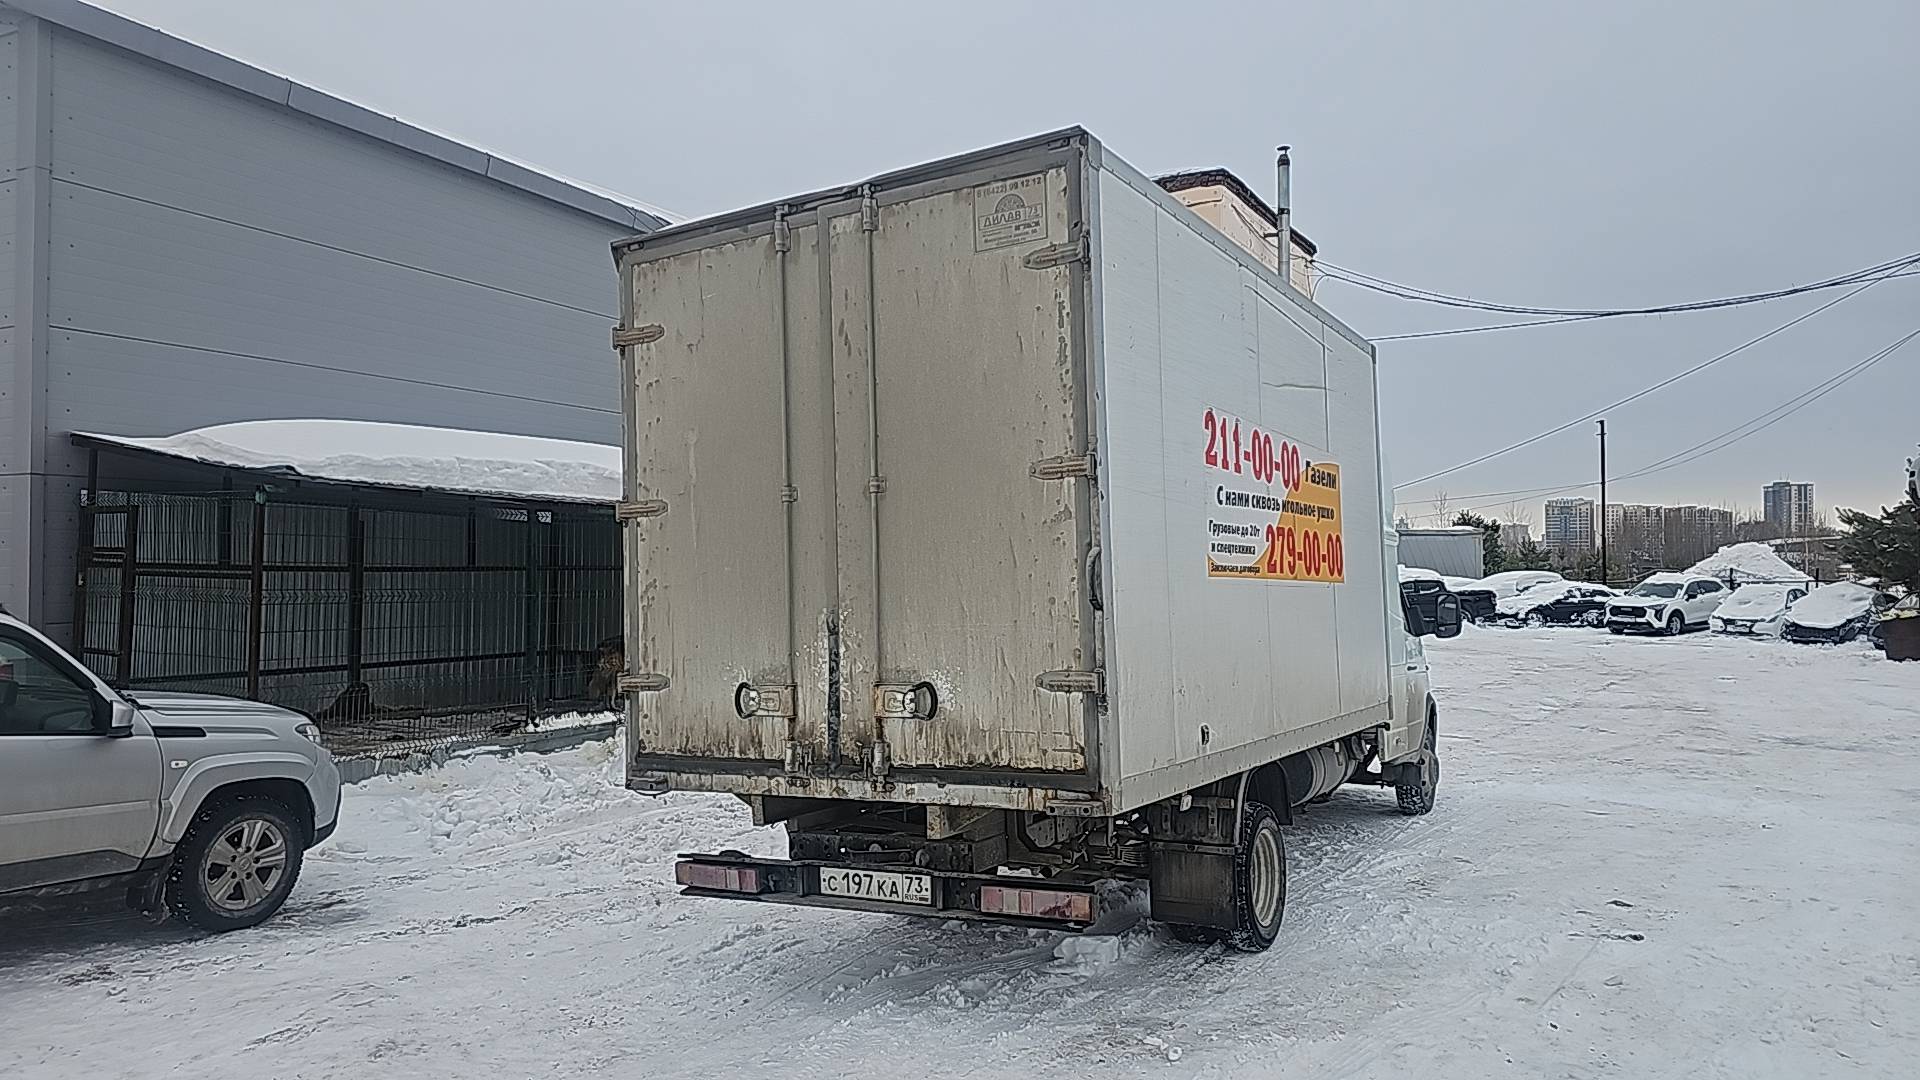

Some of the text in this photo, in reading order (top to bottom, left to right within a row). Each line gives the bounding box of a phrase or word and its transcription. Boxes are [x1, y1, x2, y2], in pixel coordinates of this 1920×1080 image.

[1204, 409, 1301, 493] 211-00-00
[1305, 460, 1337, 490] Газели
[1217, 485, 1335, 523] С нами сквозь игольное ушко
[1208, 519, 1240, 537] Грузовые
[1241, 526, 1249, 538] до
[1216, 542, 1256, 556] спецтехника
[1265, 523, 1343, 578] 279-00-00
[904, 875, 924, 894] 73
[904, 893, 919, 901] RUS
